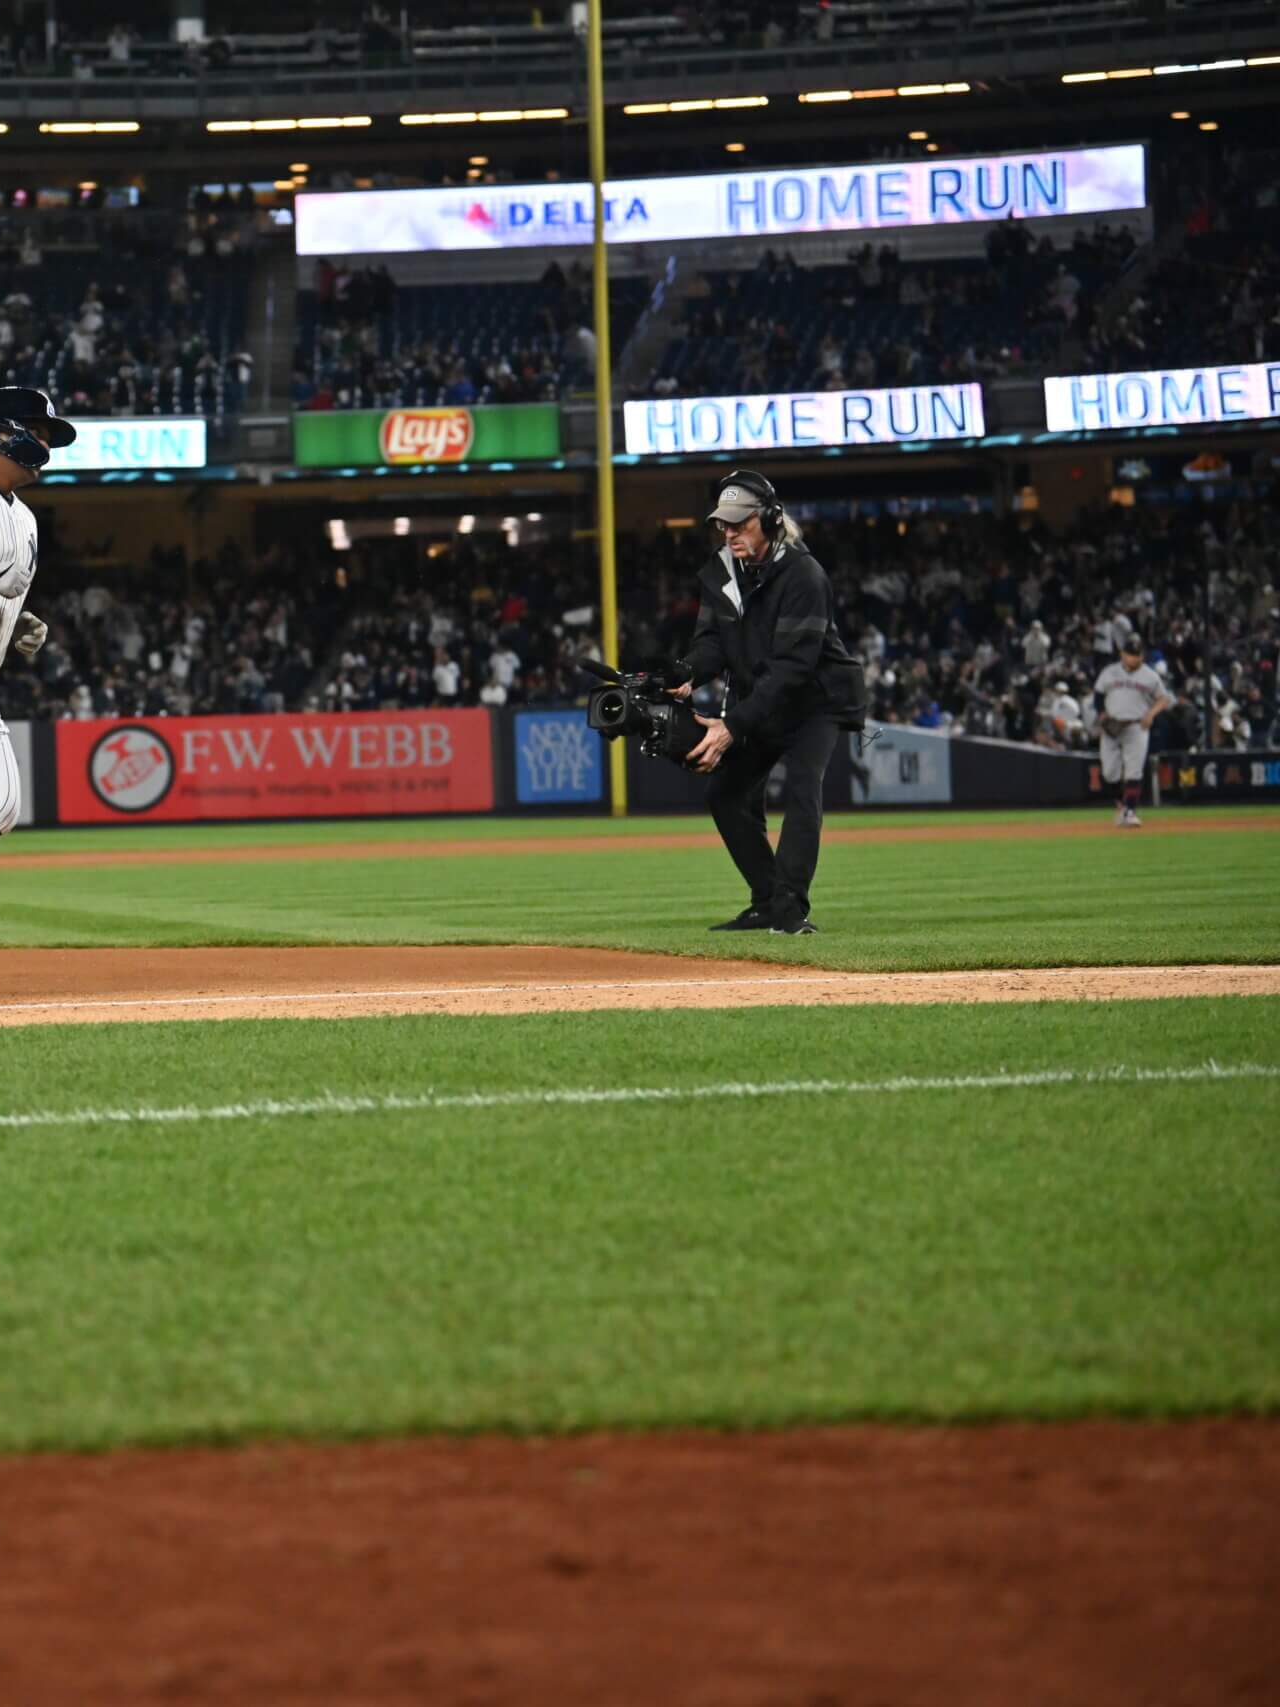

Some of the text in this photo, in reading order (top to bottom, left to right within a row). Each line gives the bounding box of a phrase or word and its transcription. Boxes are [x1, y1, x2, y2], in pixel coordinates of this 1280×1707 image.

[508, 159, 1068, 229] DELTA HOME RUN
[646, 388, 968, 448] HOME RUN
[1067, 370, 1246, 424] HOME
[99, 428, 190, 463] RUN
[291, 723, 453, 770] WEBB
[522, 743, 593, 768] YORK
[529, 723, 586, 745] NEW
